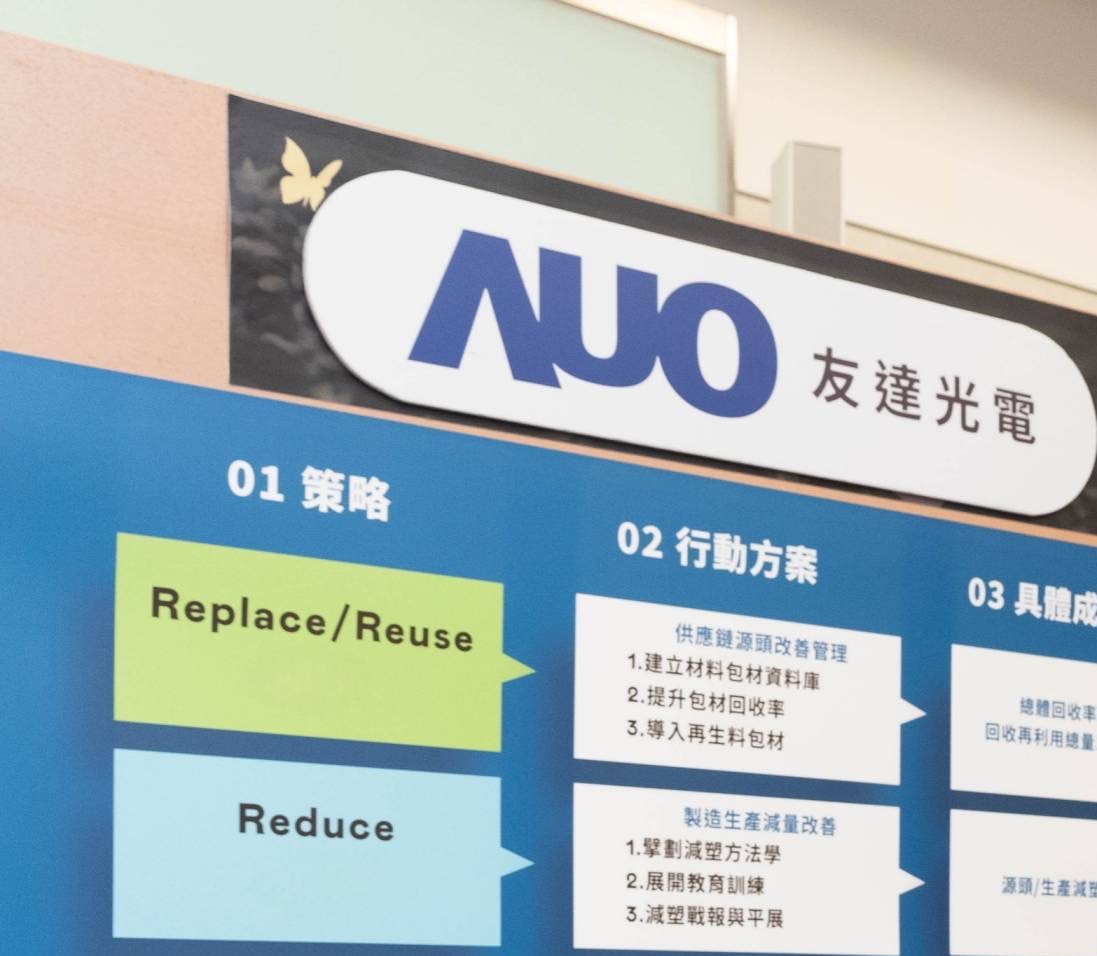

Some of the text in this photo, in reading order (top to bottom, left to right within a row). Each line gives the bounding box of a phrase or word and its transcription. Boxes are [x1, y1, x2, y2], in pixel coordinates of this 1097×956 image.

[408, 228, 1037, 445] AUO 友達光電
[227, 458, 392, 522] 01 策略
[617, 521, 818, 586] 02 行動方案
[968, 577, 1005, 610] 03
[151, 585, 474, 652] Replace/Reuse
[675, 622, 849, 664] 供應鏈源頭改善管理
[628, 652, 821, 690] 1.建立材料包材資料庫
[627, 686, 785, 719] 2.提升包材回收率
[626, 719, 784, 751] 3.導入再生料包材
[238, 803, 395, 842] Reduce
[683, 806, 837, 837] 製造生產減量改善
[626, 871, 764, 896] 2.展開教育訓練
[626, 904, 784, 928] 3.減塑戰報與平展
